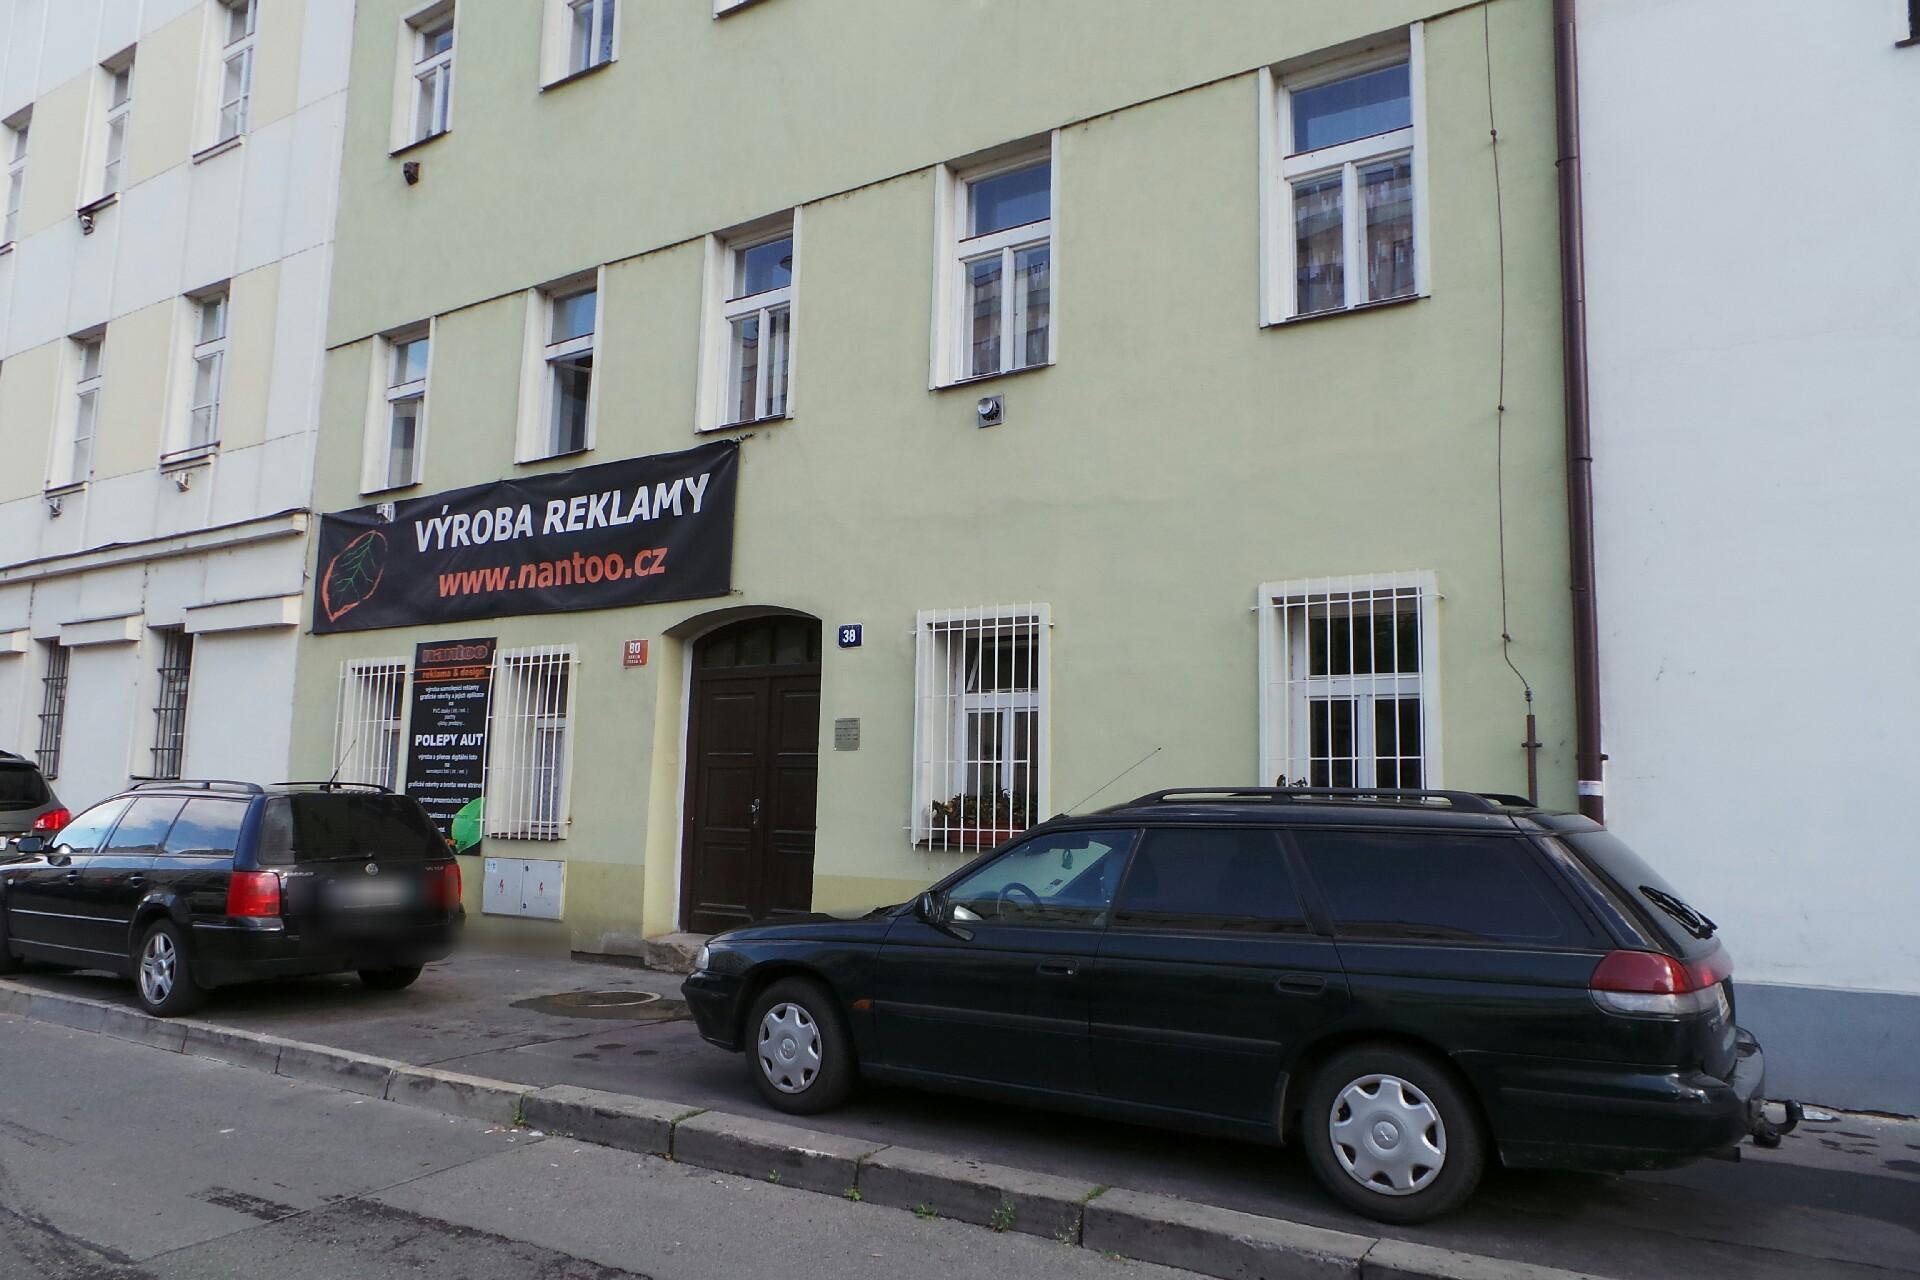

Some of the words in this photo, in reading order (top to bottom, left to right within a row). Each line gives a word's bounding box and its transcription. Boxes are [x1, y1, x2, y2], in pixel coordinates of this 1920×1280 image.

[414, 504, 534, 553] VÝROBA
[543, 472, 711, 534] REKLAMY
[438, 546, 669, 598] www.nantoo.cz
[842, 629, 856, 643] 38
[629, 642, 641, 654] 80
[415, 734, 459, 747] POLEPY
[460, 733, 484, 746] AUT
